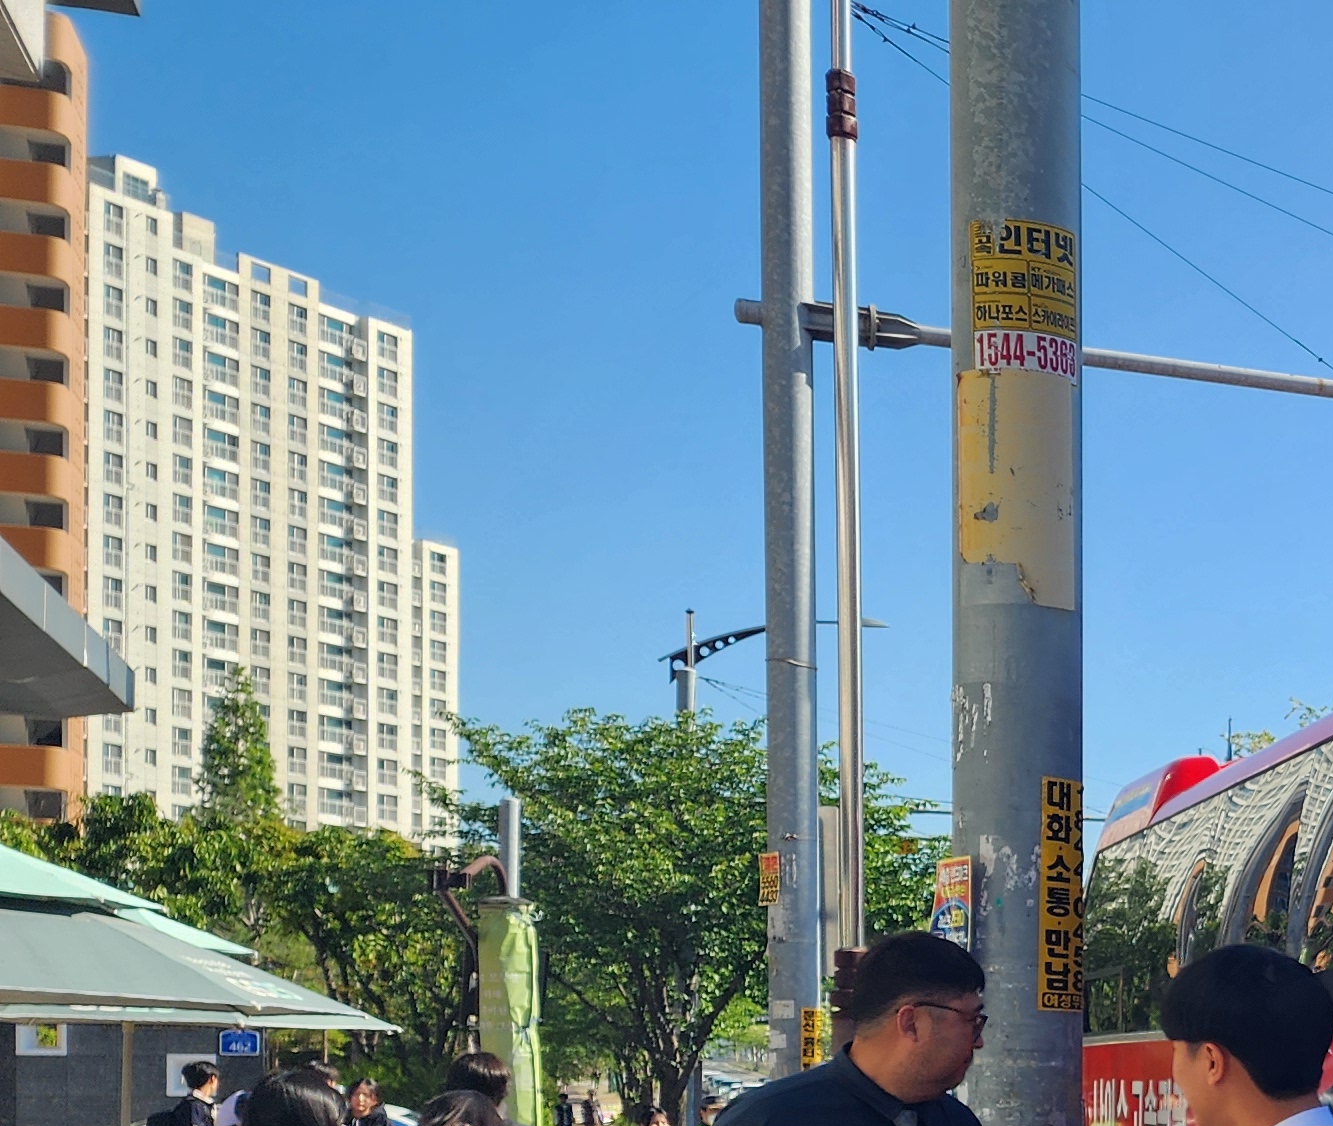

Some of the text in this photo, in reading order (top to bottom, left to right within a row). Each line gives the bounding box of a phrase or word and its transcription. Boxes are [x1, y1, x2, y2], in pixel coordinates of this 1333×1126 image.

[999, 225, 1073, 267] 인터넷
[975, 271, 1026, 289] 파워콤
[1031, 273, 1074, 298] 메가패스
[976, 304, 1027, 322] 하나포스
